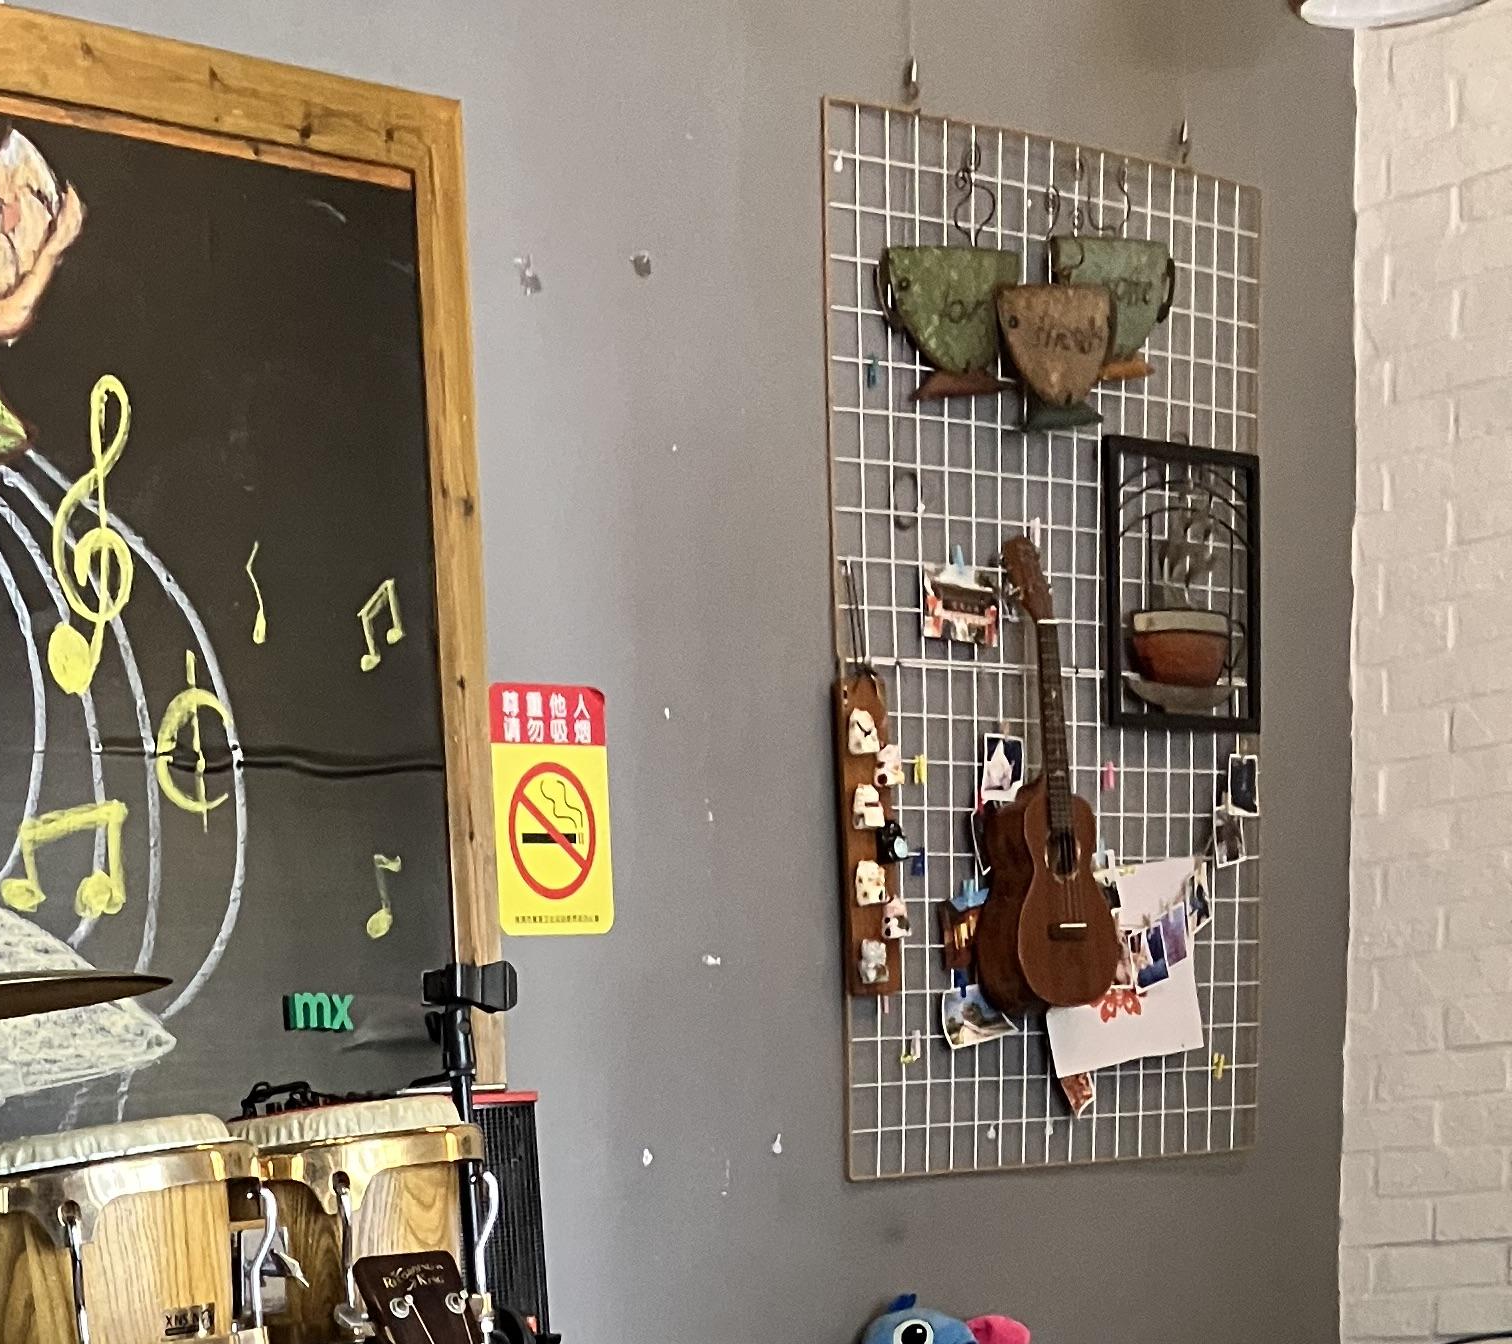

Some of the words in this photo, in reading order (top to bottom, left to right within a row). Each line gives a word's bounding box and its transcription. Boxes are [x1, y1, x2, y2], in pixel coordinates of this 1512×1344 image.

[502, 689, 590, 718] 尊重他人
[504, 716, 592, 743] 请勿吸烟
[292, 992, 354, 1030] mx
